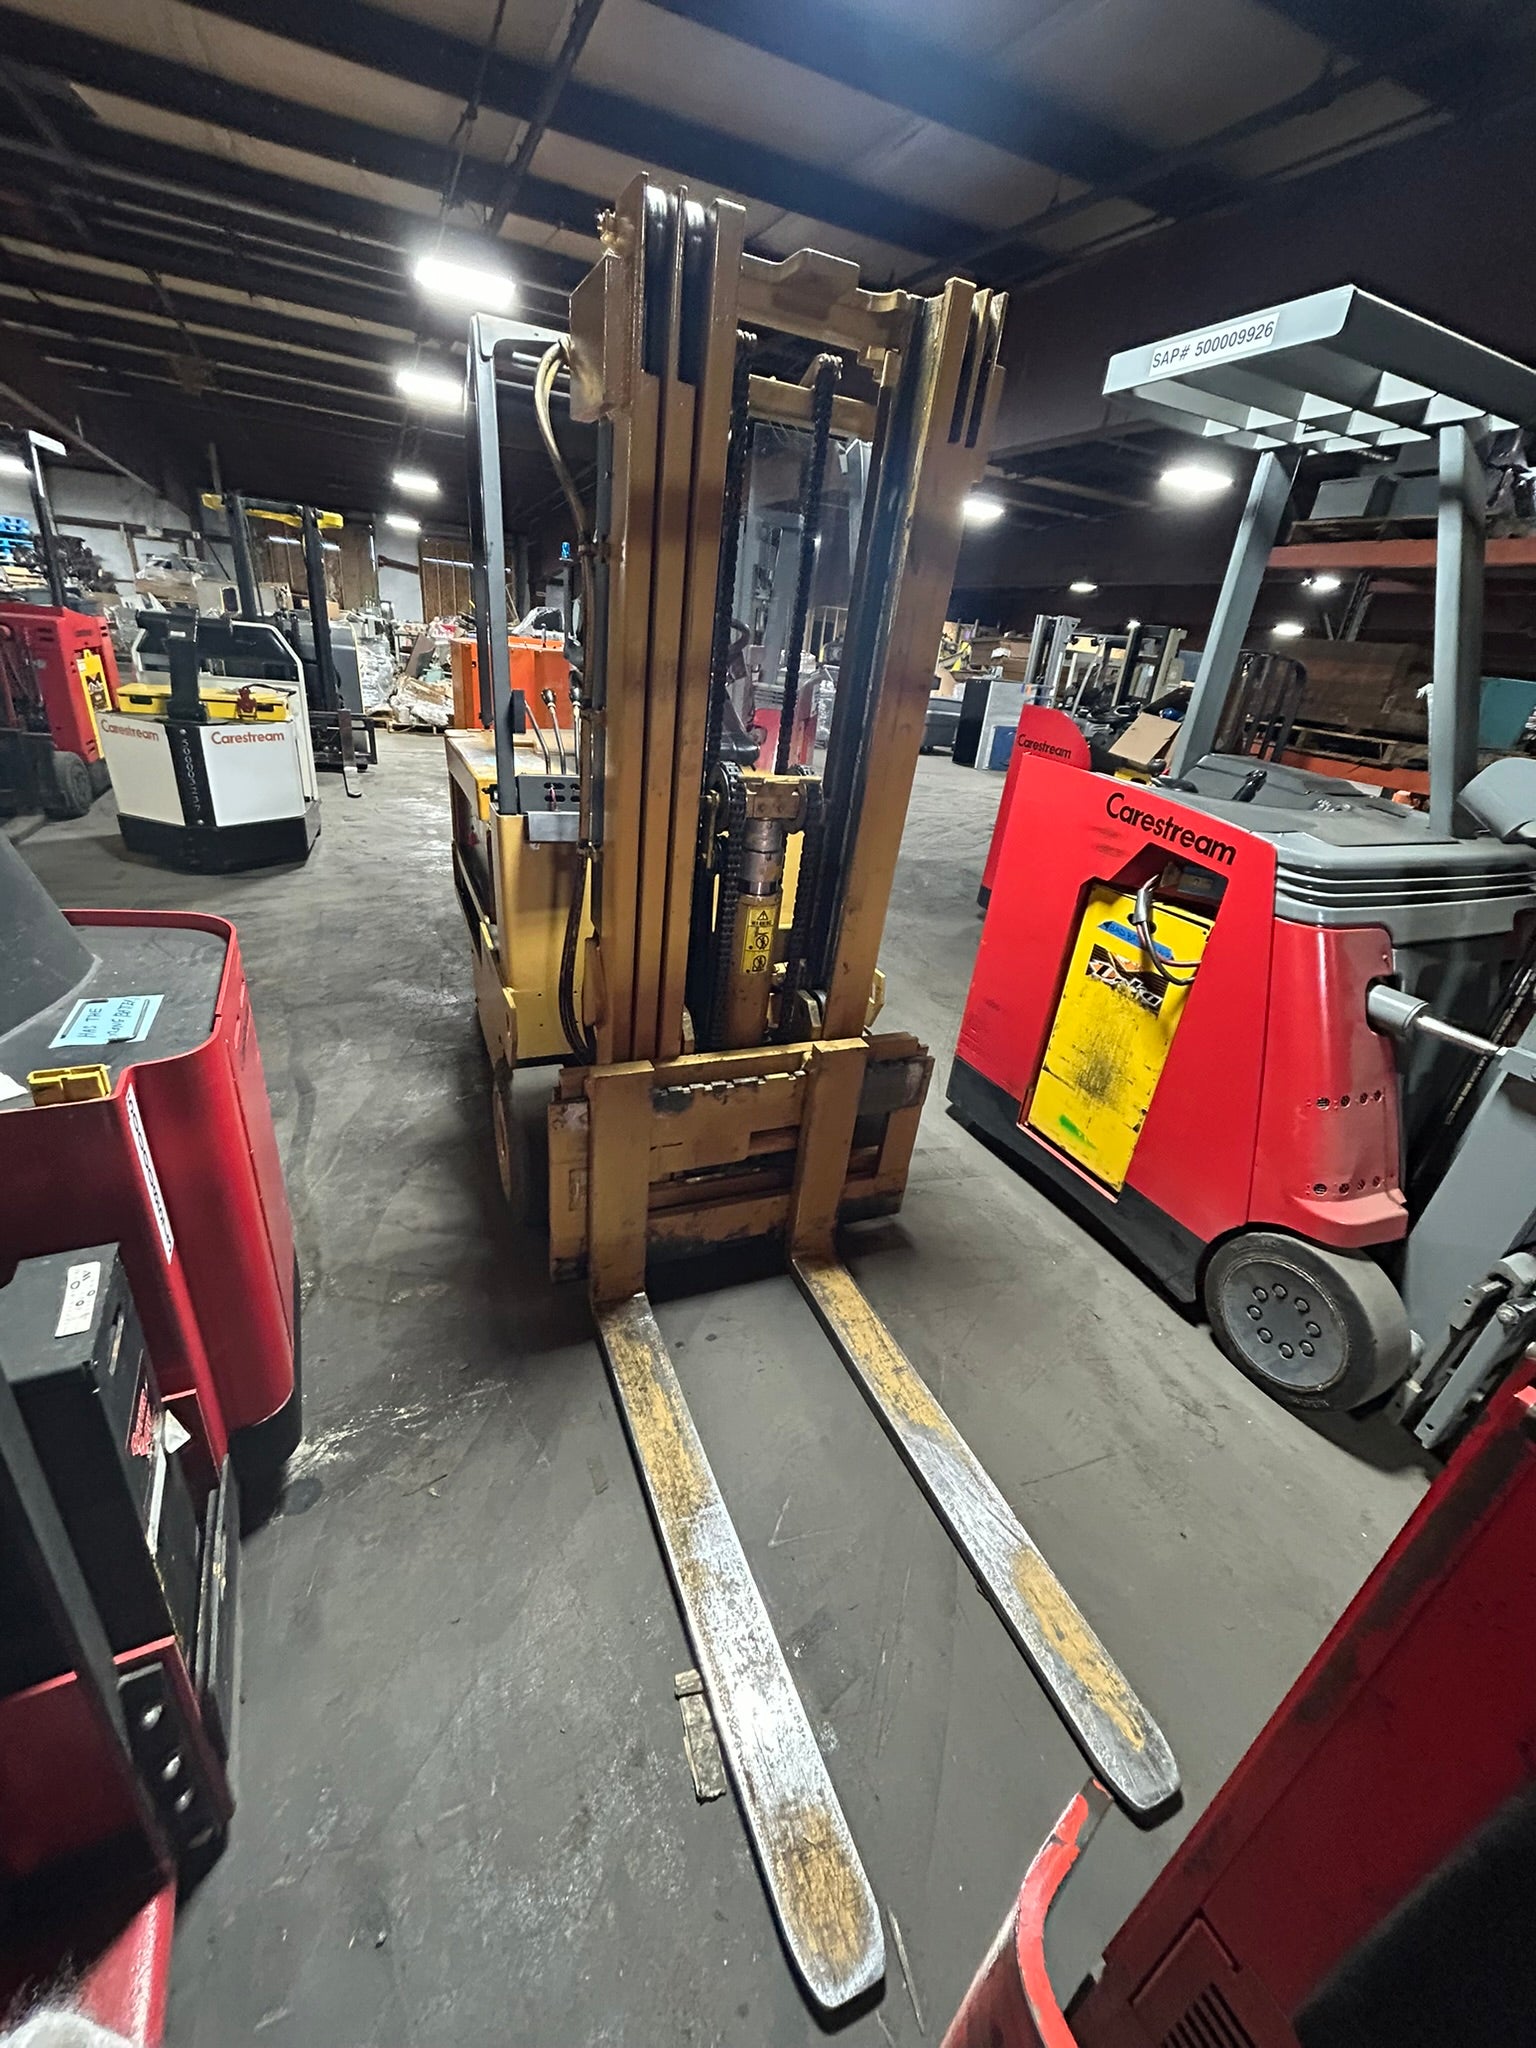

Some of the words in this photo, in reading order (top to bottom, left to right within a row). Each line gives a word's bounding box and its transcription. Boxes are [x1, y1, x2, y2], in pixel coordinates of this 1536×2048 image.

[1152, 344, 1191, 368] SAP#
[1194, 321, 1275, 357] 500009926
[101, 719, 159, 742] Carestream
[211, 731, 285, 745] Carestream
[1017, 733, 1072, 759] Carestream
[1106, 792, 1237, 866] Carestream
